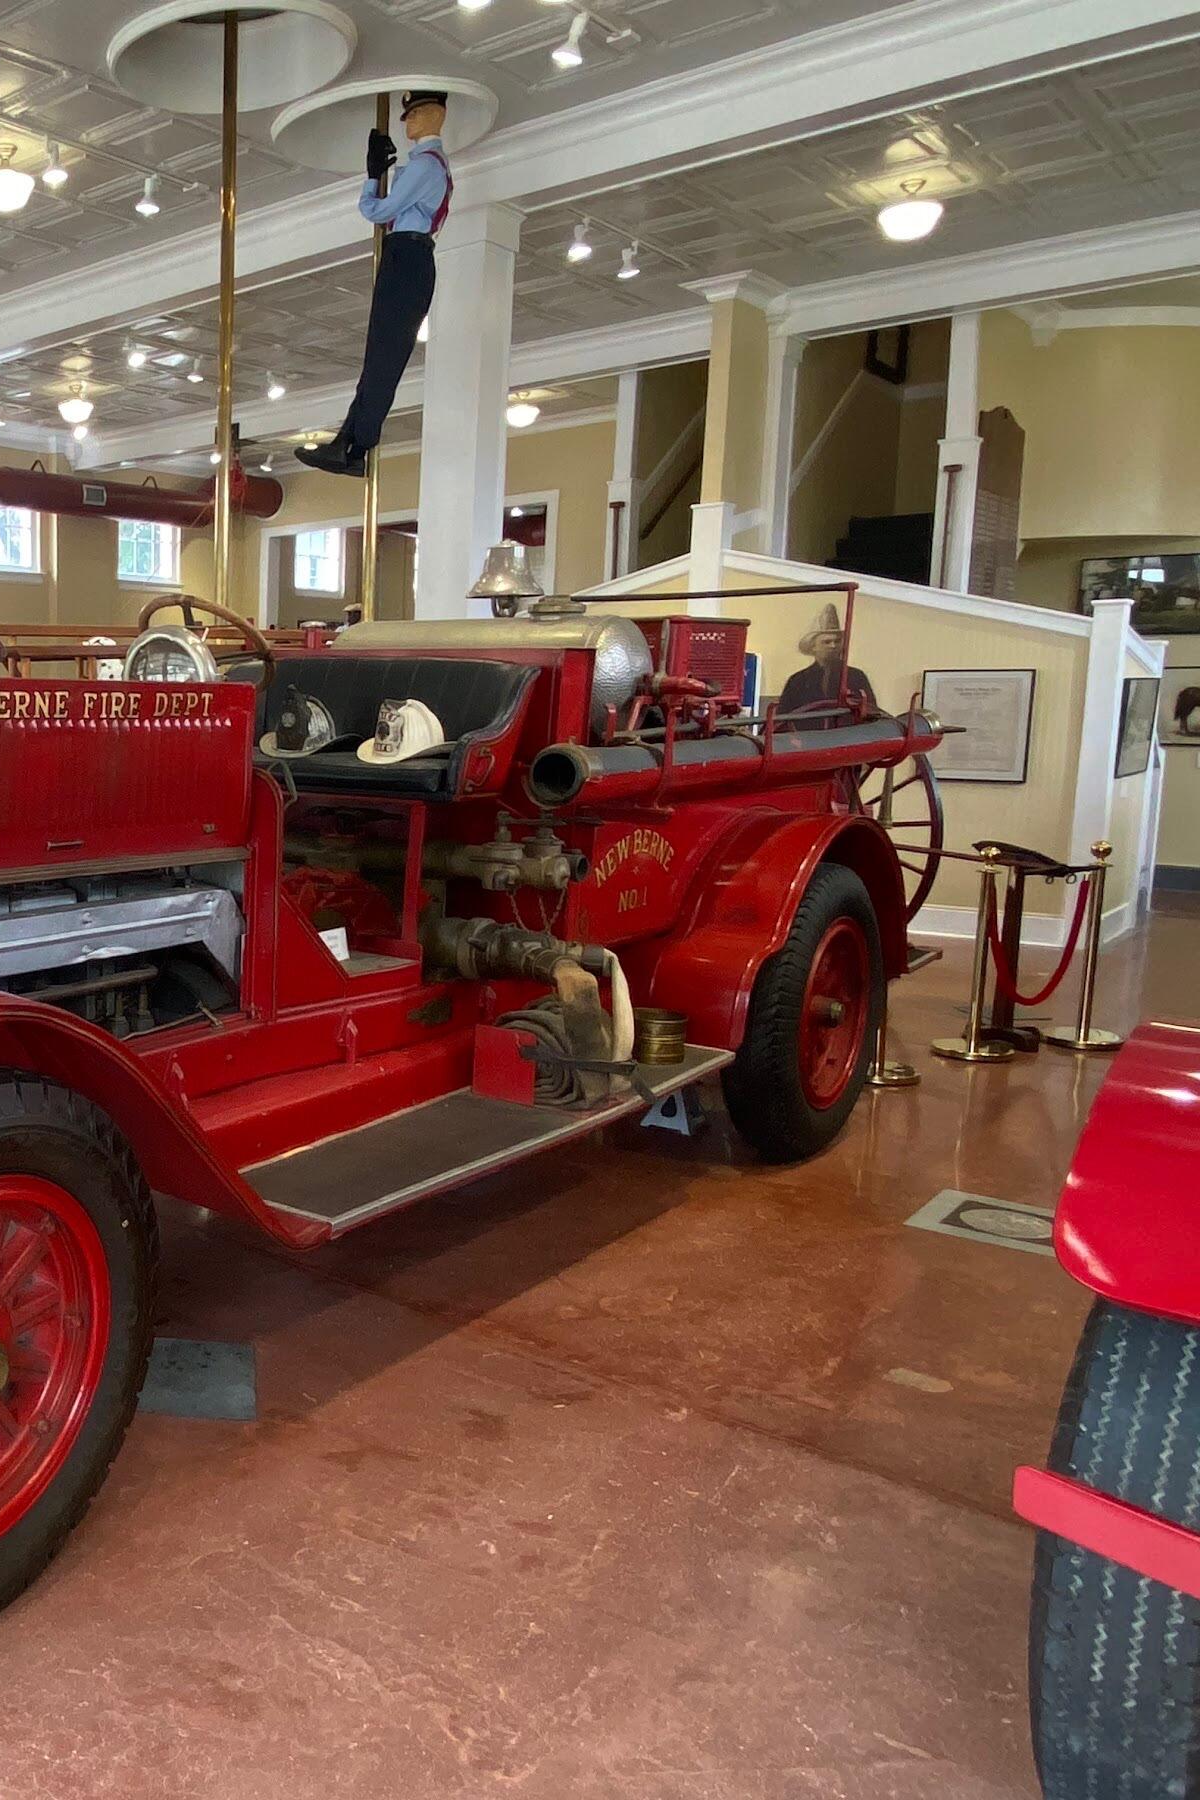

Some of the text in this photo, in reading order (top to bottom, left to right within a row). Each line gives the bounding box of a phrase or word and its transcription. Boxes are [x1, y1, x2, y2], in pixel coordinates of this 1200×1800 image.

[83, 692, 141, 720] FIRE
[594, 828, 674, 889] NEW BERNE
